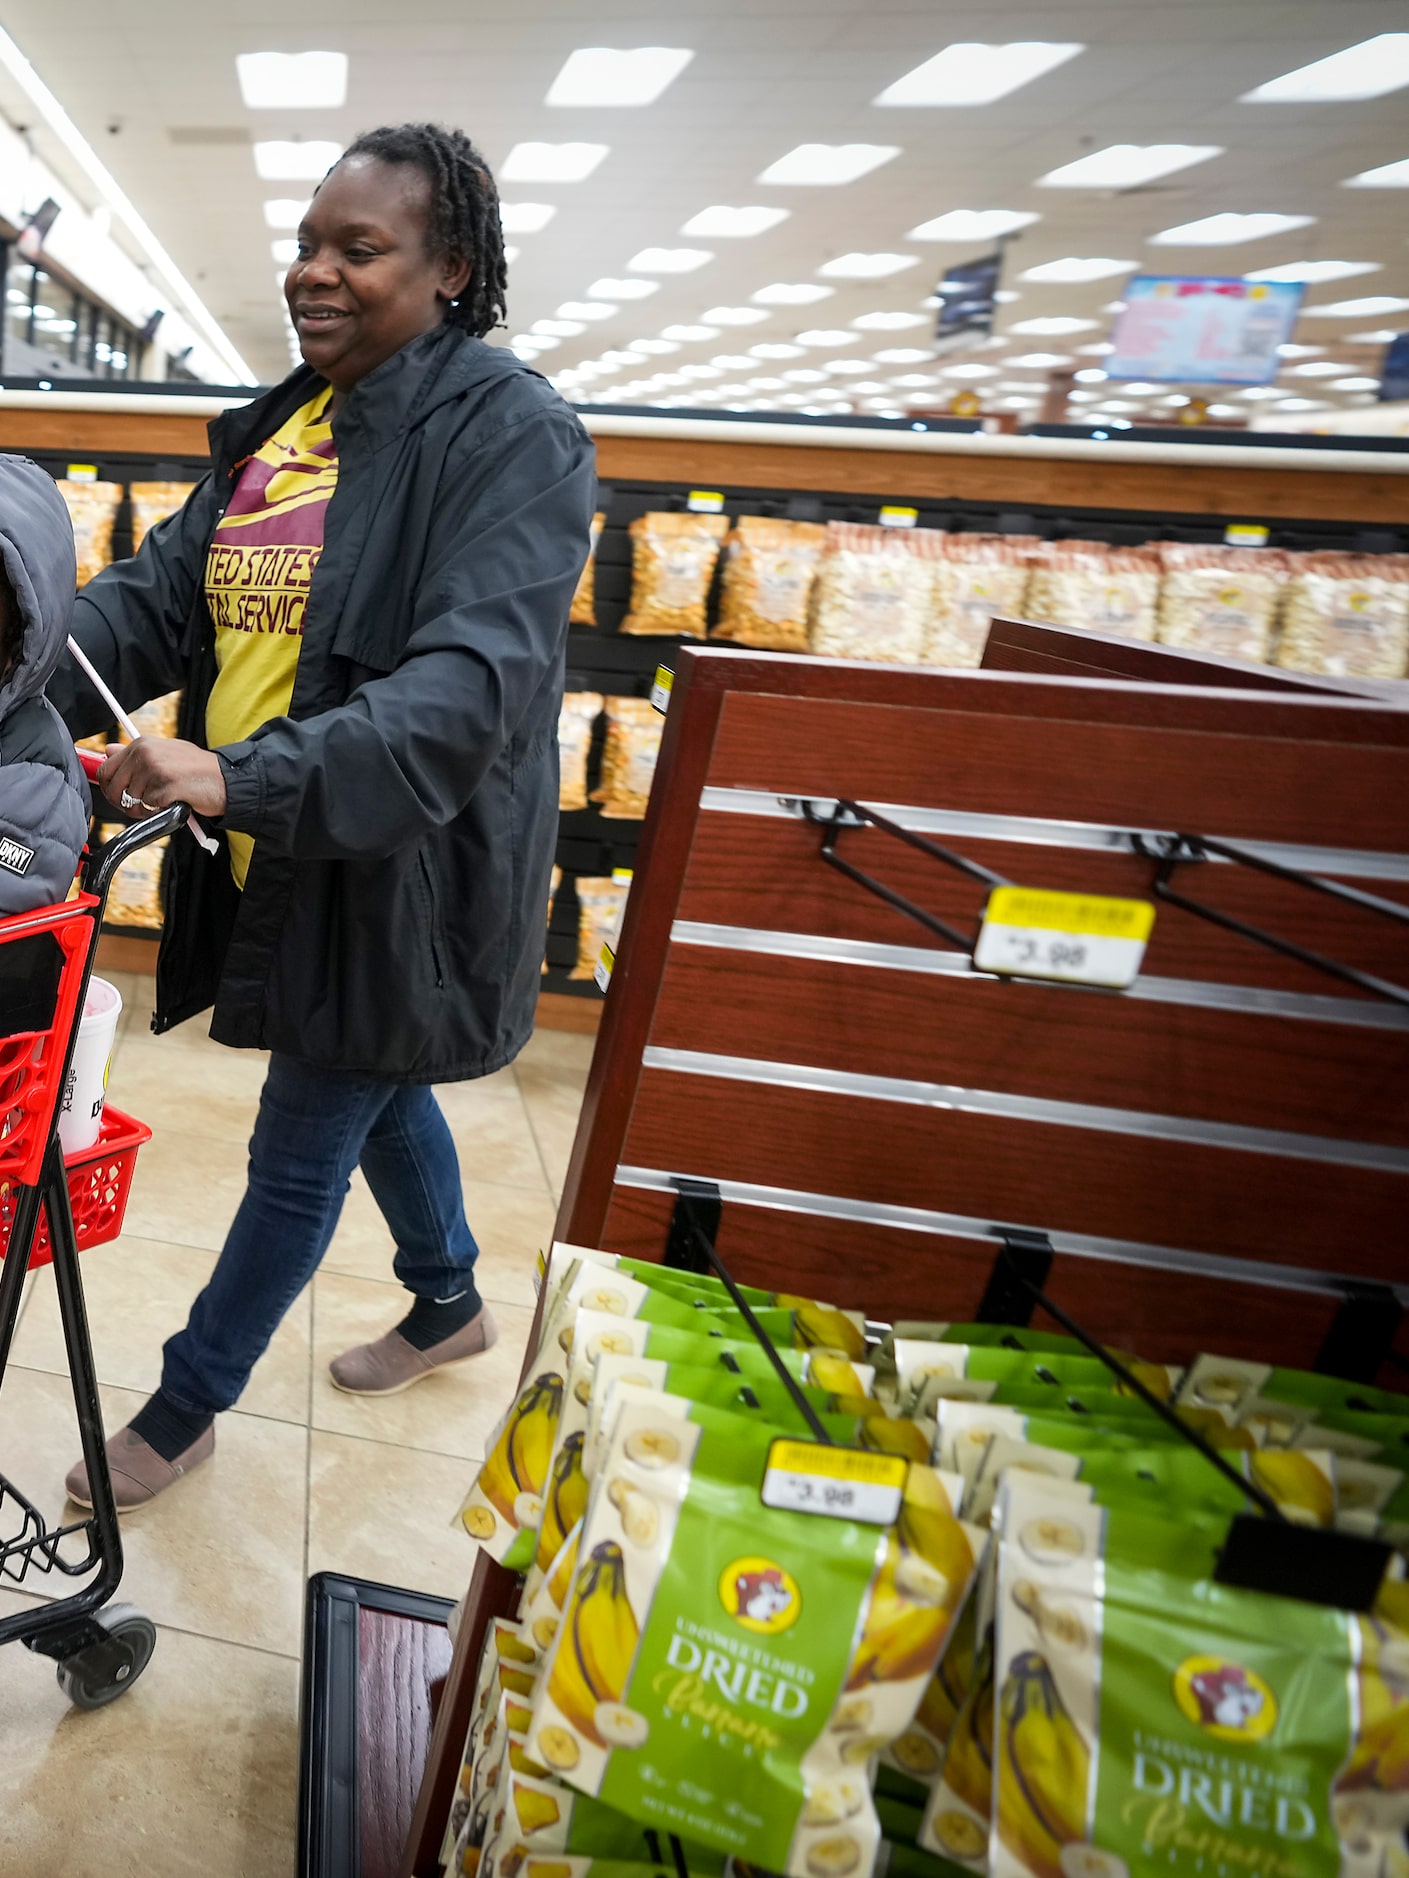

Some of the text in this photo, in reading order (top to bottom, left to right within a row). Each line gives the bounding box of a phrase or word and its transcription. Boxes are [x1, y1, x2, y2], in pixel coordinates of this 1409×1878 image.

[207, 547, 244, 585] TED
[206, 592, 234, 629] TAL
[0, 841, 30, 869] DKNY
[665, 1633, 810, 1719] DRIED
[1132, 1752, 1317, 1840] DRIED
